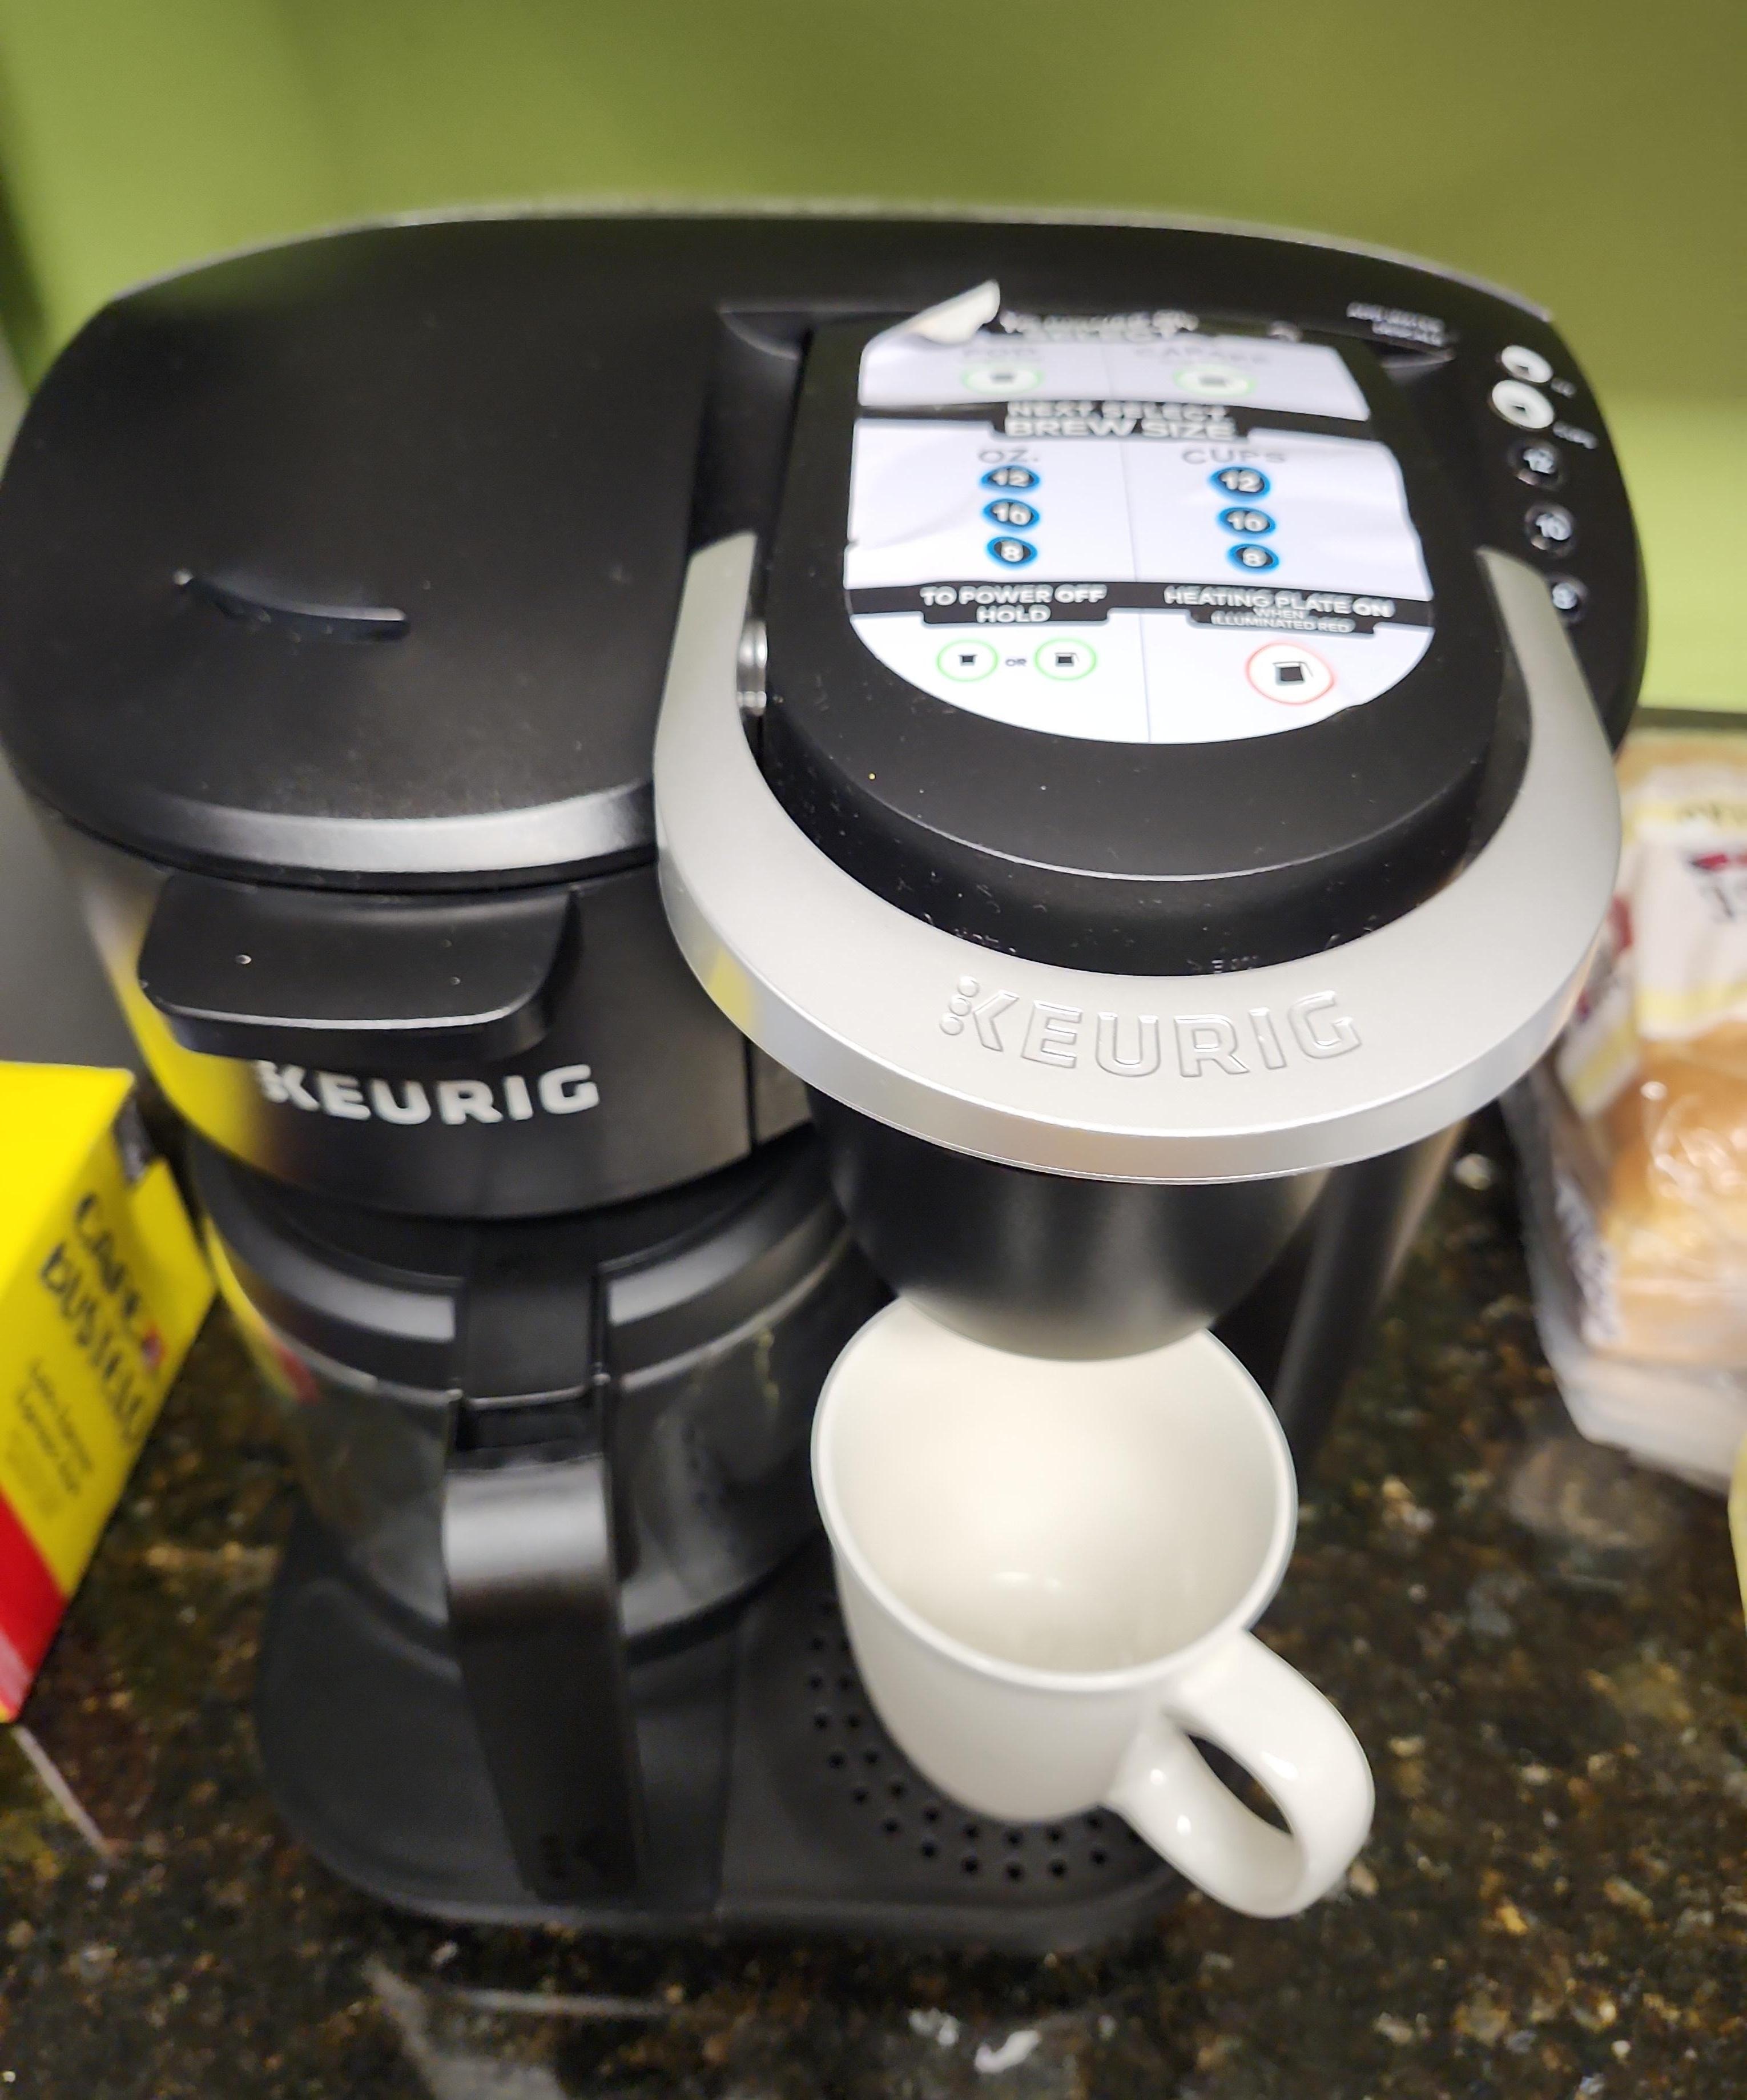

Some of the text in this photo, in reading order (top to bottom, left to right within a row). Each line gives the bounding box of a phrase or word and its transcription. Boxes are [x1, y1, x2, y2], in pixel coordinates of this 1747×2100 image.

[1007, 400, 1229, 422] NEXT SELECT
[1005, 417, 1237, 441] BREW SIZE
[977, 449, 1040, 463] OZ.
[1182, 448, 1287, 465] CUPS
[991, 467, 1032, 488] 12
[1220, 469, 1262, 493] 12
[991, 501, 1032, 526] 10
[1226, 510, 1269, 532] 10
[1000, 538, 1024, 562] 8
[1242, 546, 1267, 568] 8
[919, 584, 1108, 606] TO POWER OFF
[1164, 585, 1395, 618] HEATING PLATE ON
[976, 604, 1051, 623] HOLD
[1210, 610, 1356, 633] ILLUMINATED RED
[1254, 606, 1309, 619] WHEN
[1005, 658, 1027, 667] OR
[940, 975, 1362, 1078] KEURIG
[254, 1059, 600, 1125] KEURIG
